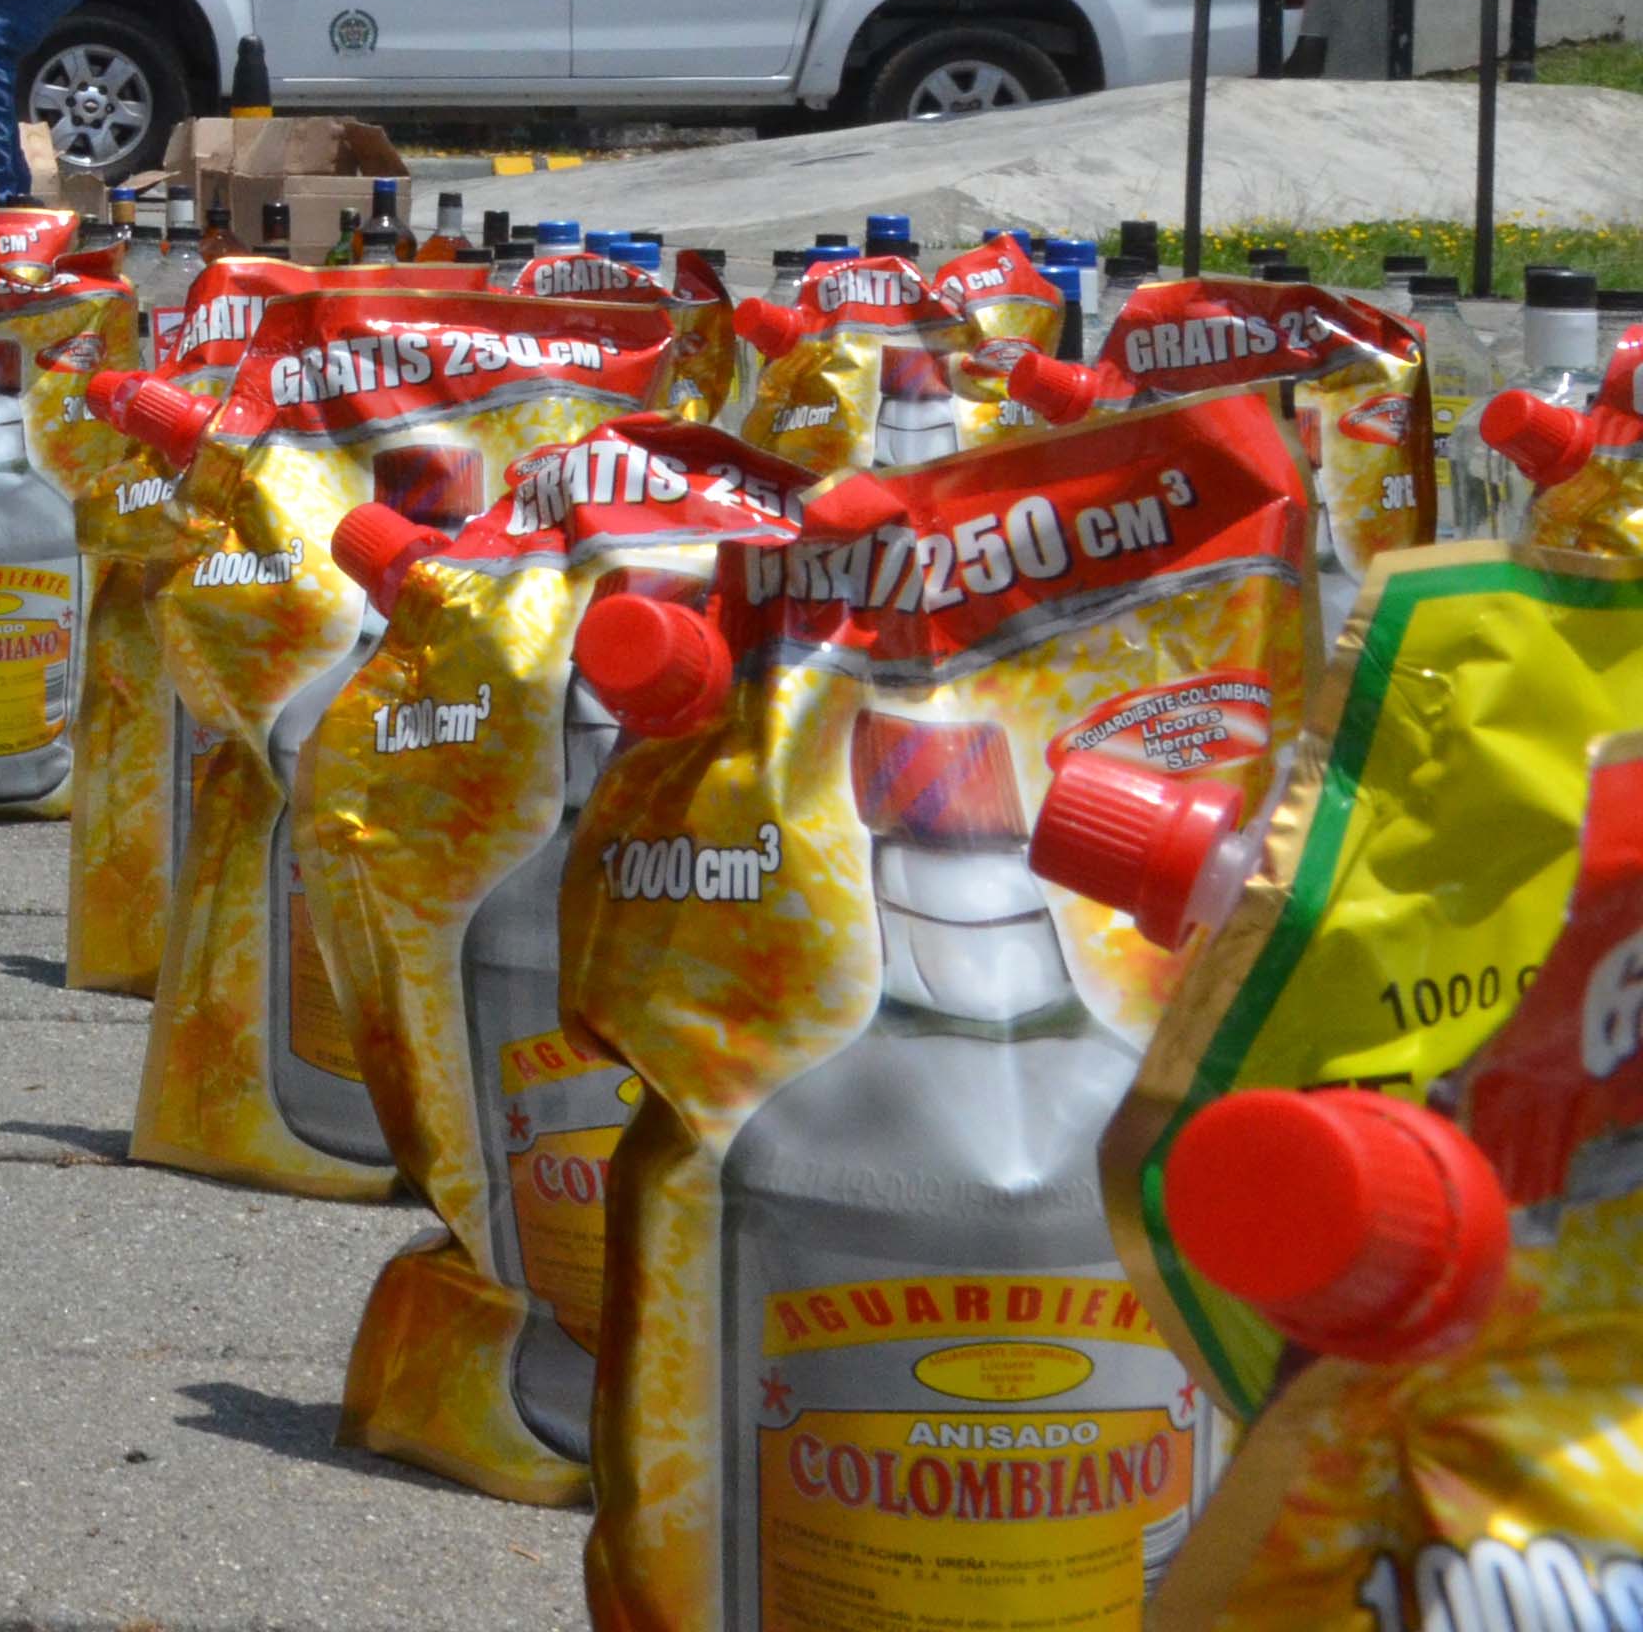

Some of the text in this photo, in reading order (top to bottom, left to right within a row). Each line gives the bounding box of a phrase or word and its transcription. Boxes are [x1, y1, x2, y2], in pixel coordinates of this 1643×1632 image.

[817, 267, 922, 313] GRATIS
[175, 295, 266, 363] GRATI
[1124, 312, 1278, 376] GRATIS
[270, 336, 433, 408] GRATIS
[441, 330, 544, 378] 250
[505, 439, 690, 536] GRATIS
[917, 493, 1072, 615] 250
[1074, 694, 1177, 754] AGUARDIENTE
[1142, 707, 1223, 739] Licores
[1145, 725, 1229, 757] Herrera
[1166, 748, 1212, 771] S.A.
[1380, 963, 1502, 1032] 1000
[773, 1283, 1158, 1342] AGUARDIEN
[906, 1420, 1101, 1450] ANISADO
[787, 1430, 1172, 1522] COLOMBIANO
